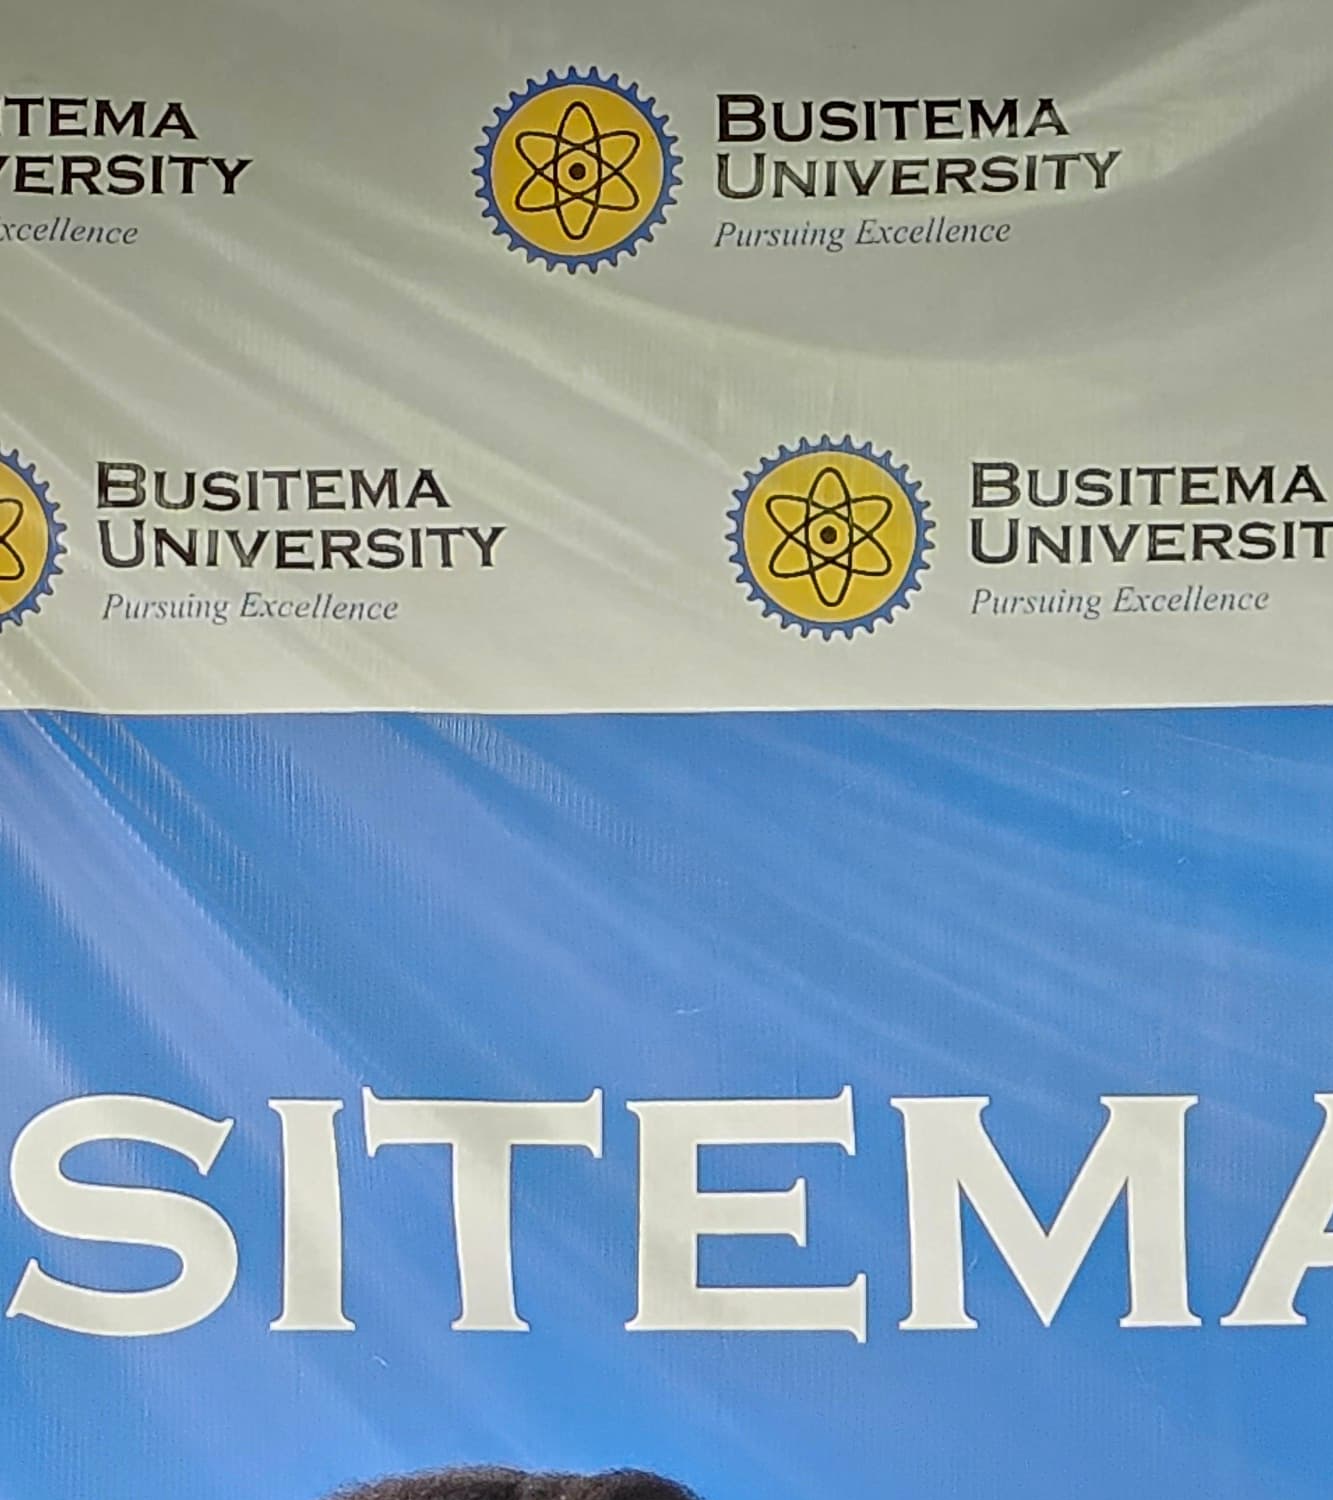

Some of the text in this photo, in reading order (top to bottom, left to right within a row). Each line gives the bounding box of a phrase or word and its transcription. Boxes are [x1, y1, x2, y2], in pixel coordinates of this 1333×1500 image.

[716, 94, 1069, 142] BUSITEMA
[717, 151, 1121, 199] UNIVERSITY
[714, 216, 1010, 252] Pursuing Excellence
[97, 461, 451, 511] BUSITEMA
[972, 462, 1327, 507] BUSITEMA
[98, 519, 506, 570] UNIVERSITY
[102, 592, 398, 625] Pursuing Excellence
[971, 585, 1269, 620] Pursuing Excellence
